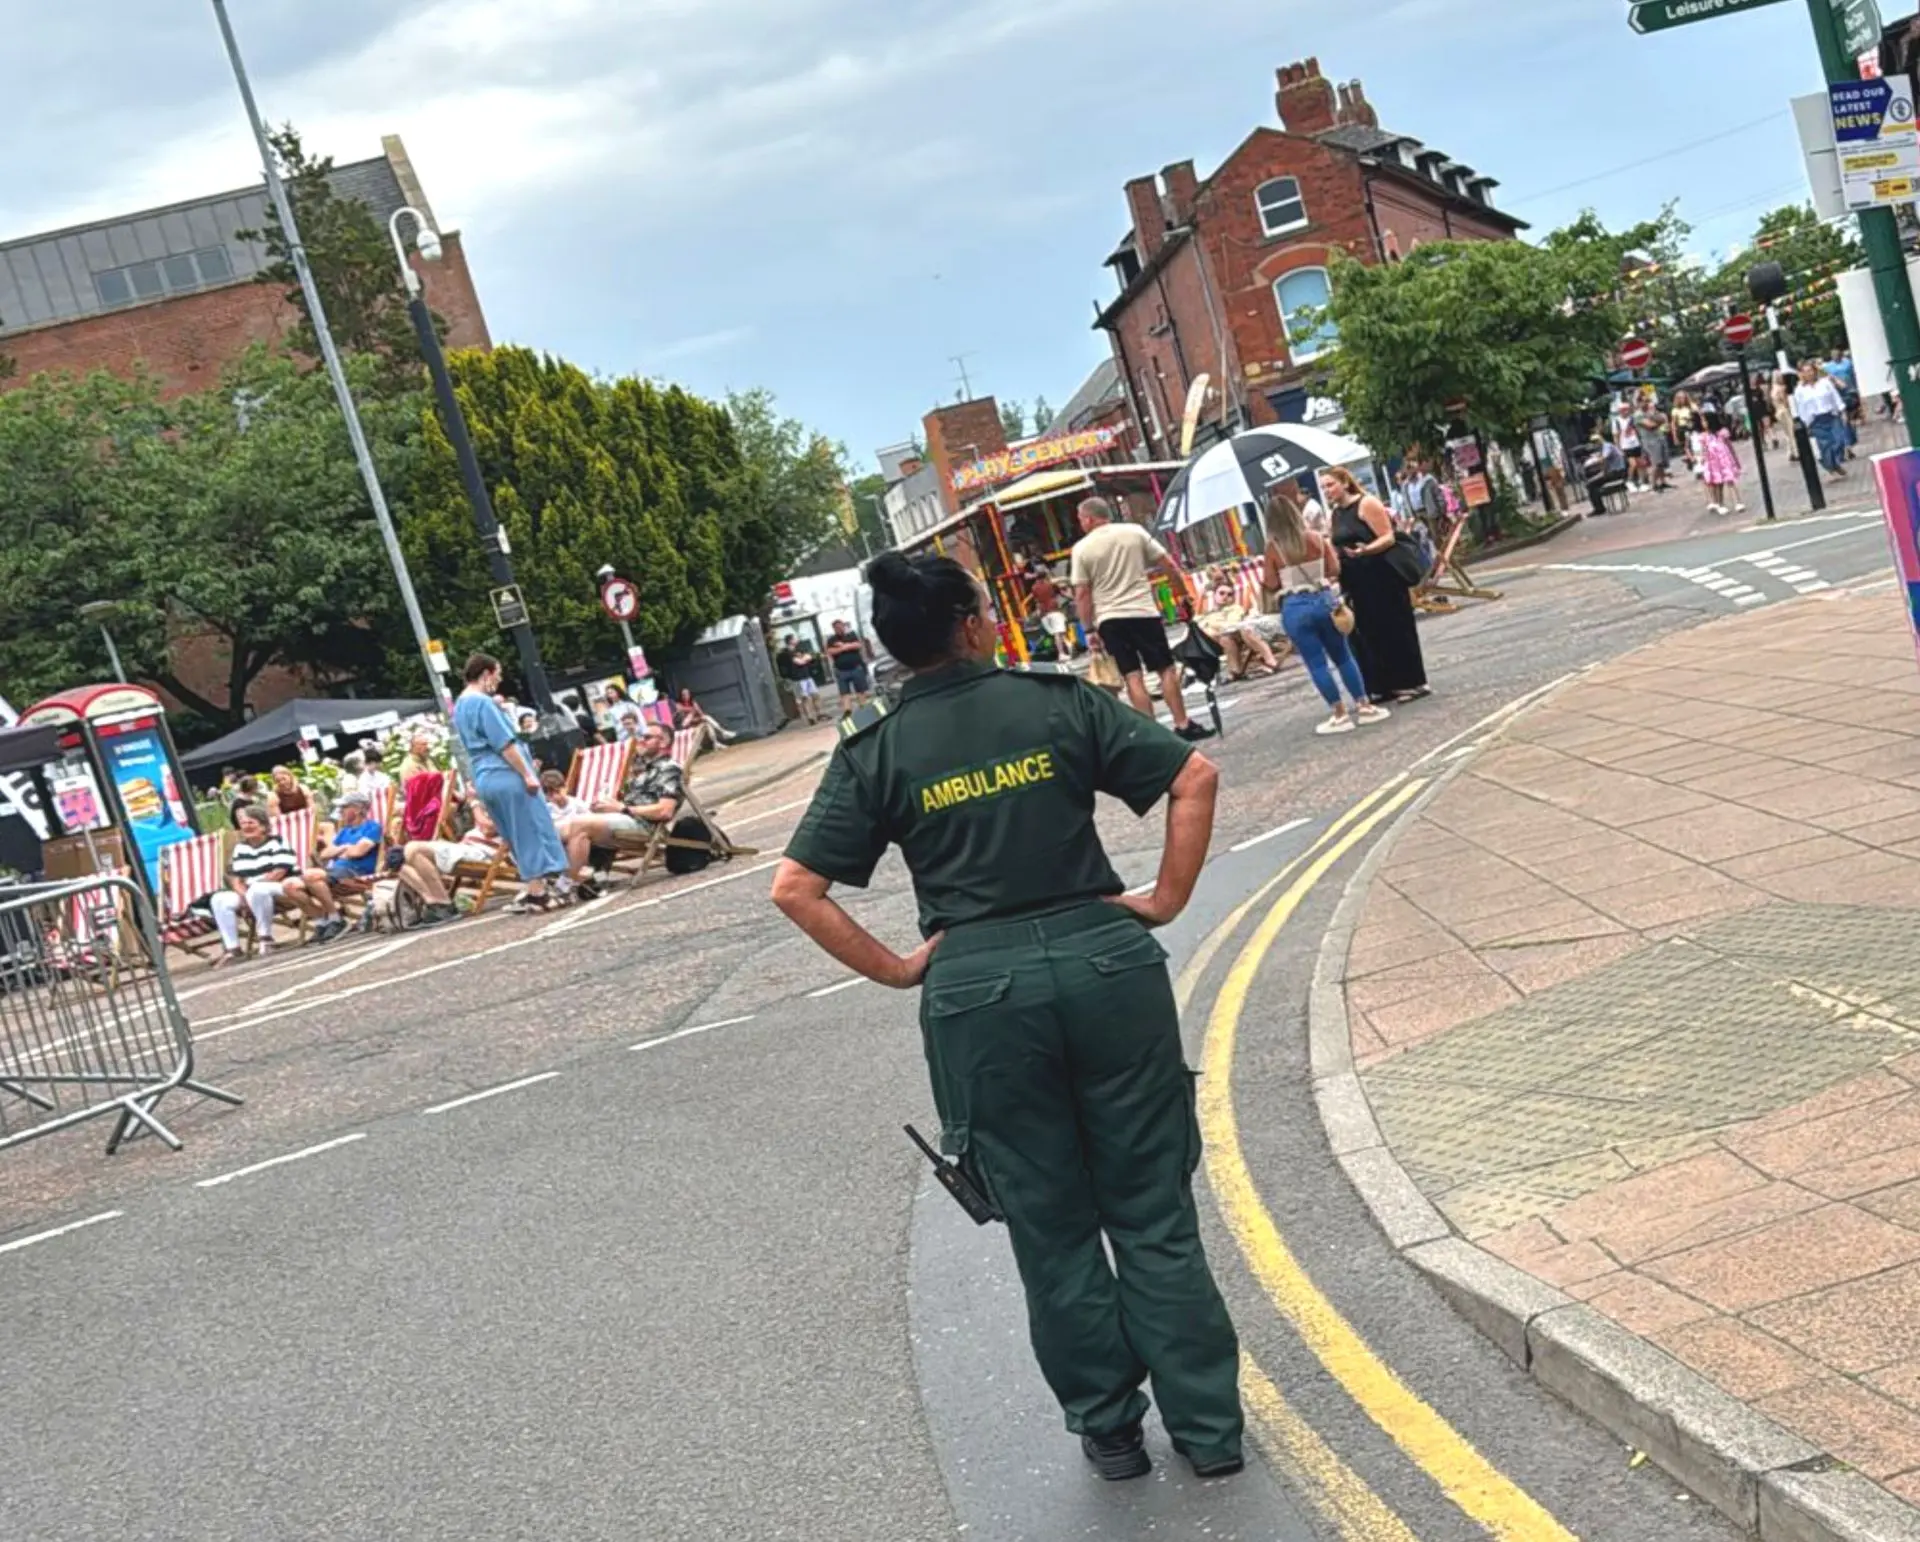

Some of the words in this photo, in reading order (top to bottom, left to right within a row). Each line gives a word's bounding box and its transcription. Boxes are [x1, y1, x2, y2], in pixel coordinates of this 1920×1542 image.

[1832, 91, 1861, 101] READ
[1862, 87, 1885, 98] OUR
[1834, 101, 1872, 114] LATEST
[1835, 112, 1881, 128] NEWS
[922, 752, 1054, 813] AMBULANCE
